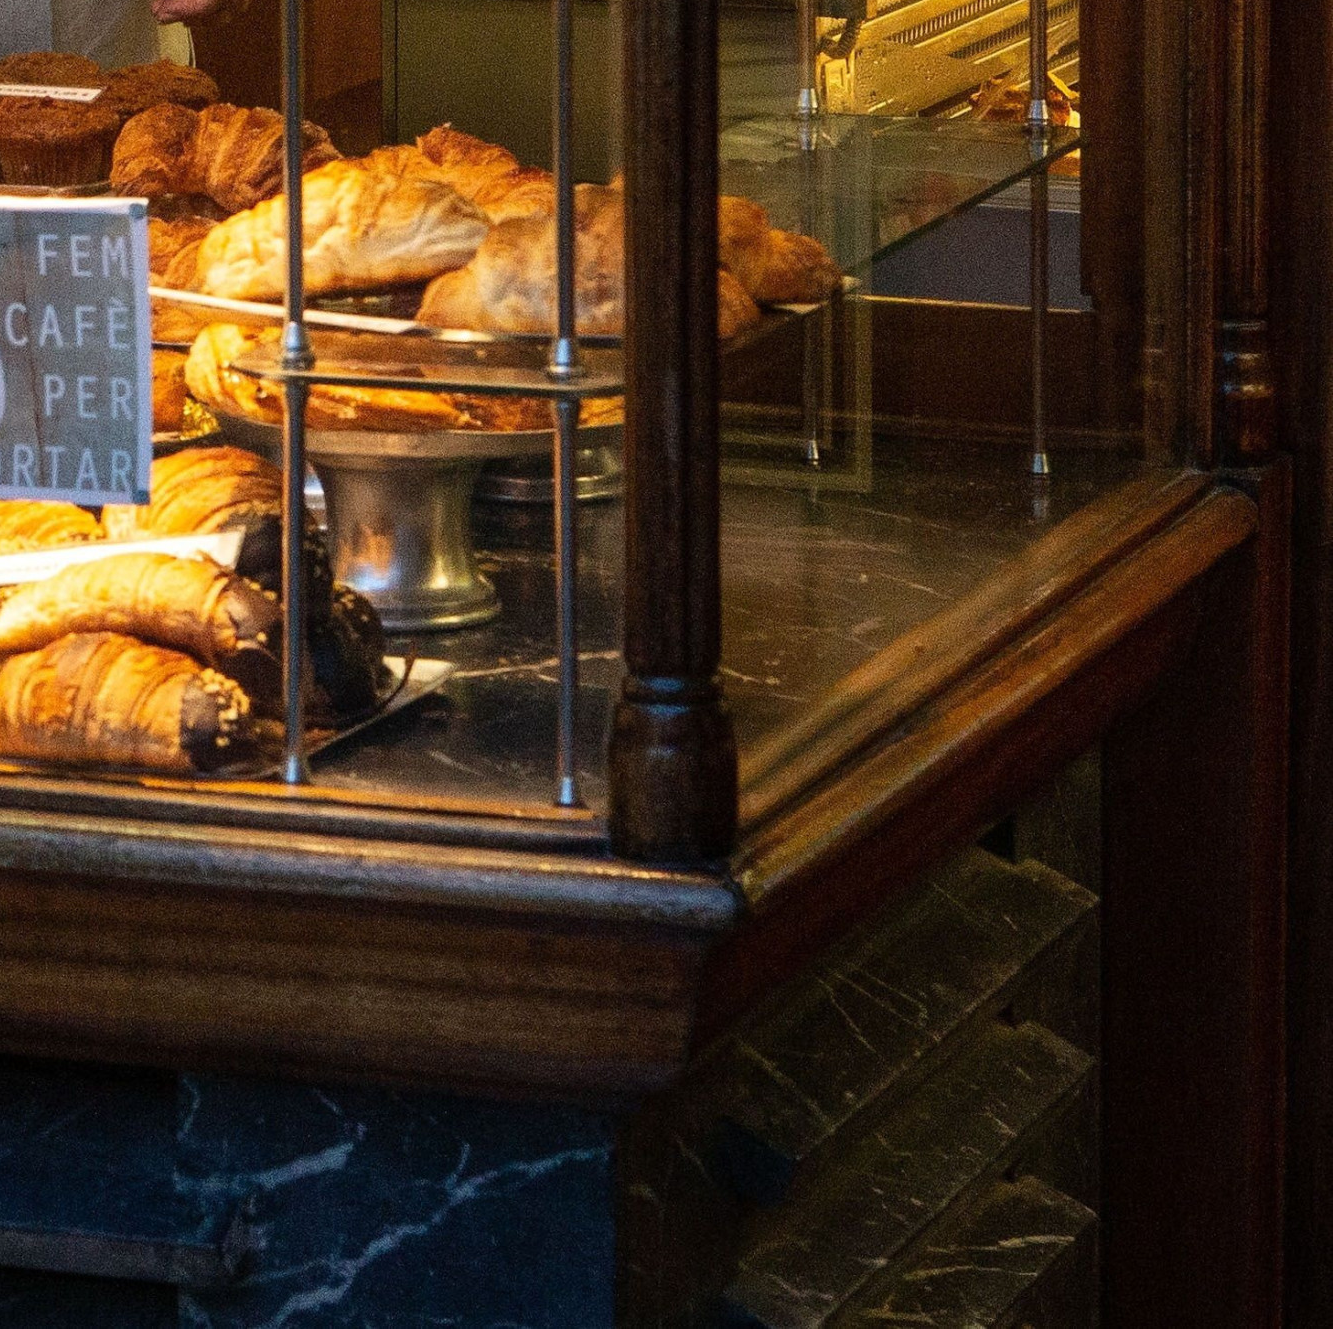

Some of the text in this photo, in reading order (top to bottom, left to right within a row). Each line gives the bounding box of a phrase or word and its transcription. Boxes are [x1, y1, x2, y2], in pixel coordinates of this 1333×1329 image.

[36, 233, 131, 280] FEM
[2, 296, 131, 350] CAFÈ
[43, 375, 136, 421] PER
